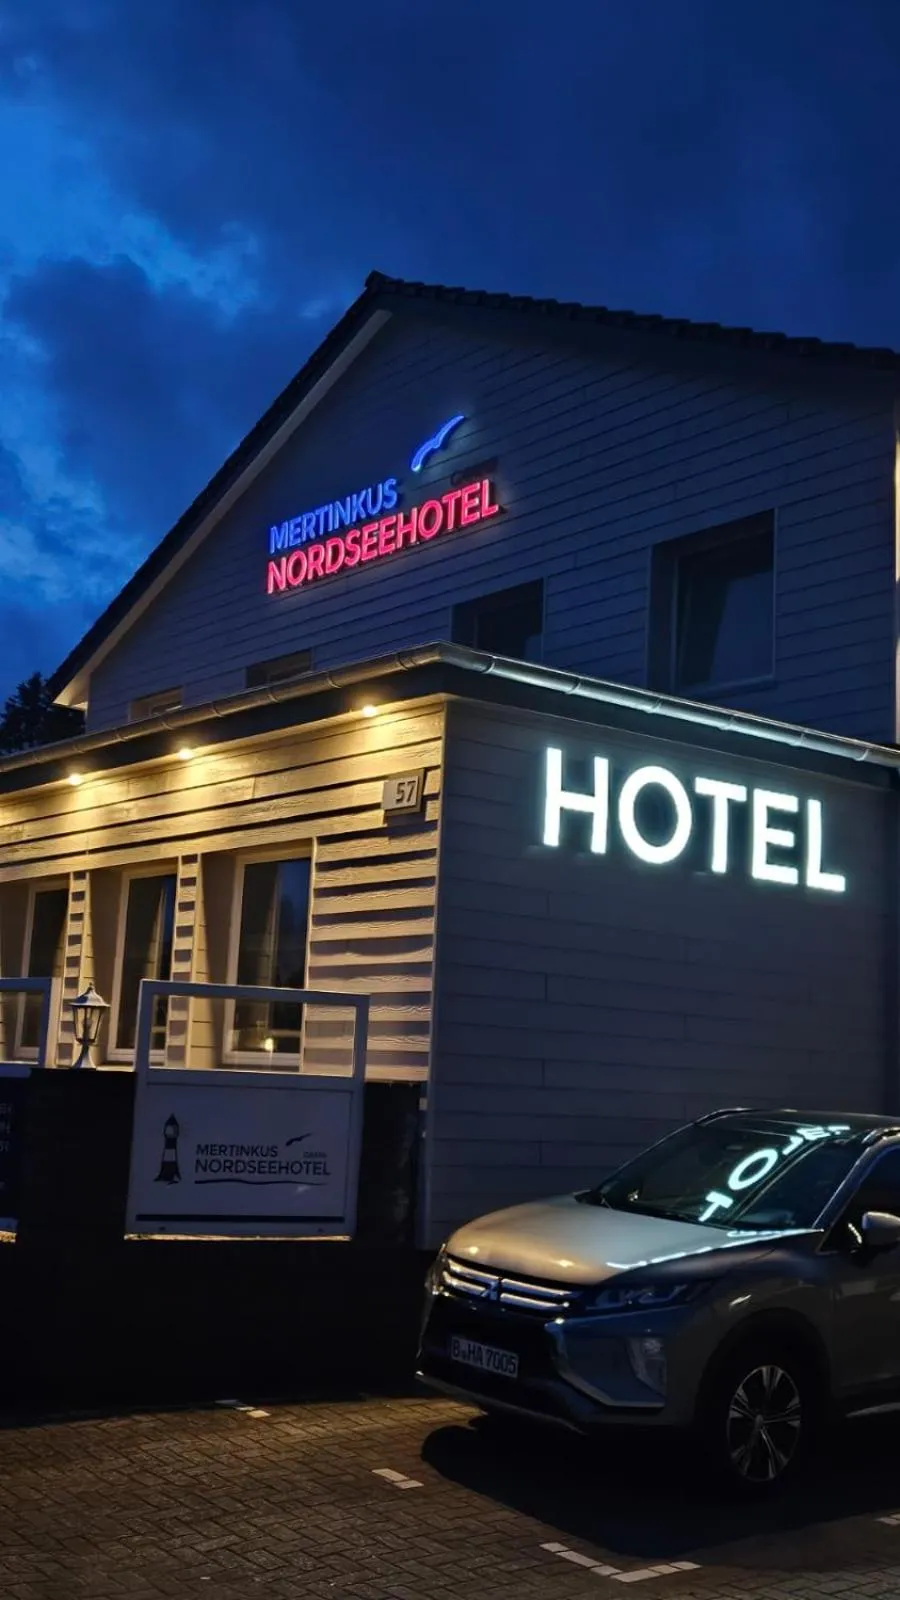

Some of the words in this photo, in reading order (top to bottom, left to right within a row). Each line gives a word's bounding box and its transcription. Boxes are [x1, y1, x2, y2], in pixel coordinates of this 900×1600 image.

[269, 477, 398, 554] MERTINKUS
[266, 478, 500, 594] NORDSEEHOTEL
[395, 780, 416, 805] 57
[542, 746, 846, 893] HOTEL
[196, 1143, 278, 1158] MERTINKUS
[195, 1158, 331, 1176] NORDSEEHOTEL
[453, 1339, 460, 1357] B
